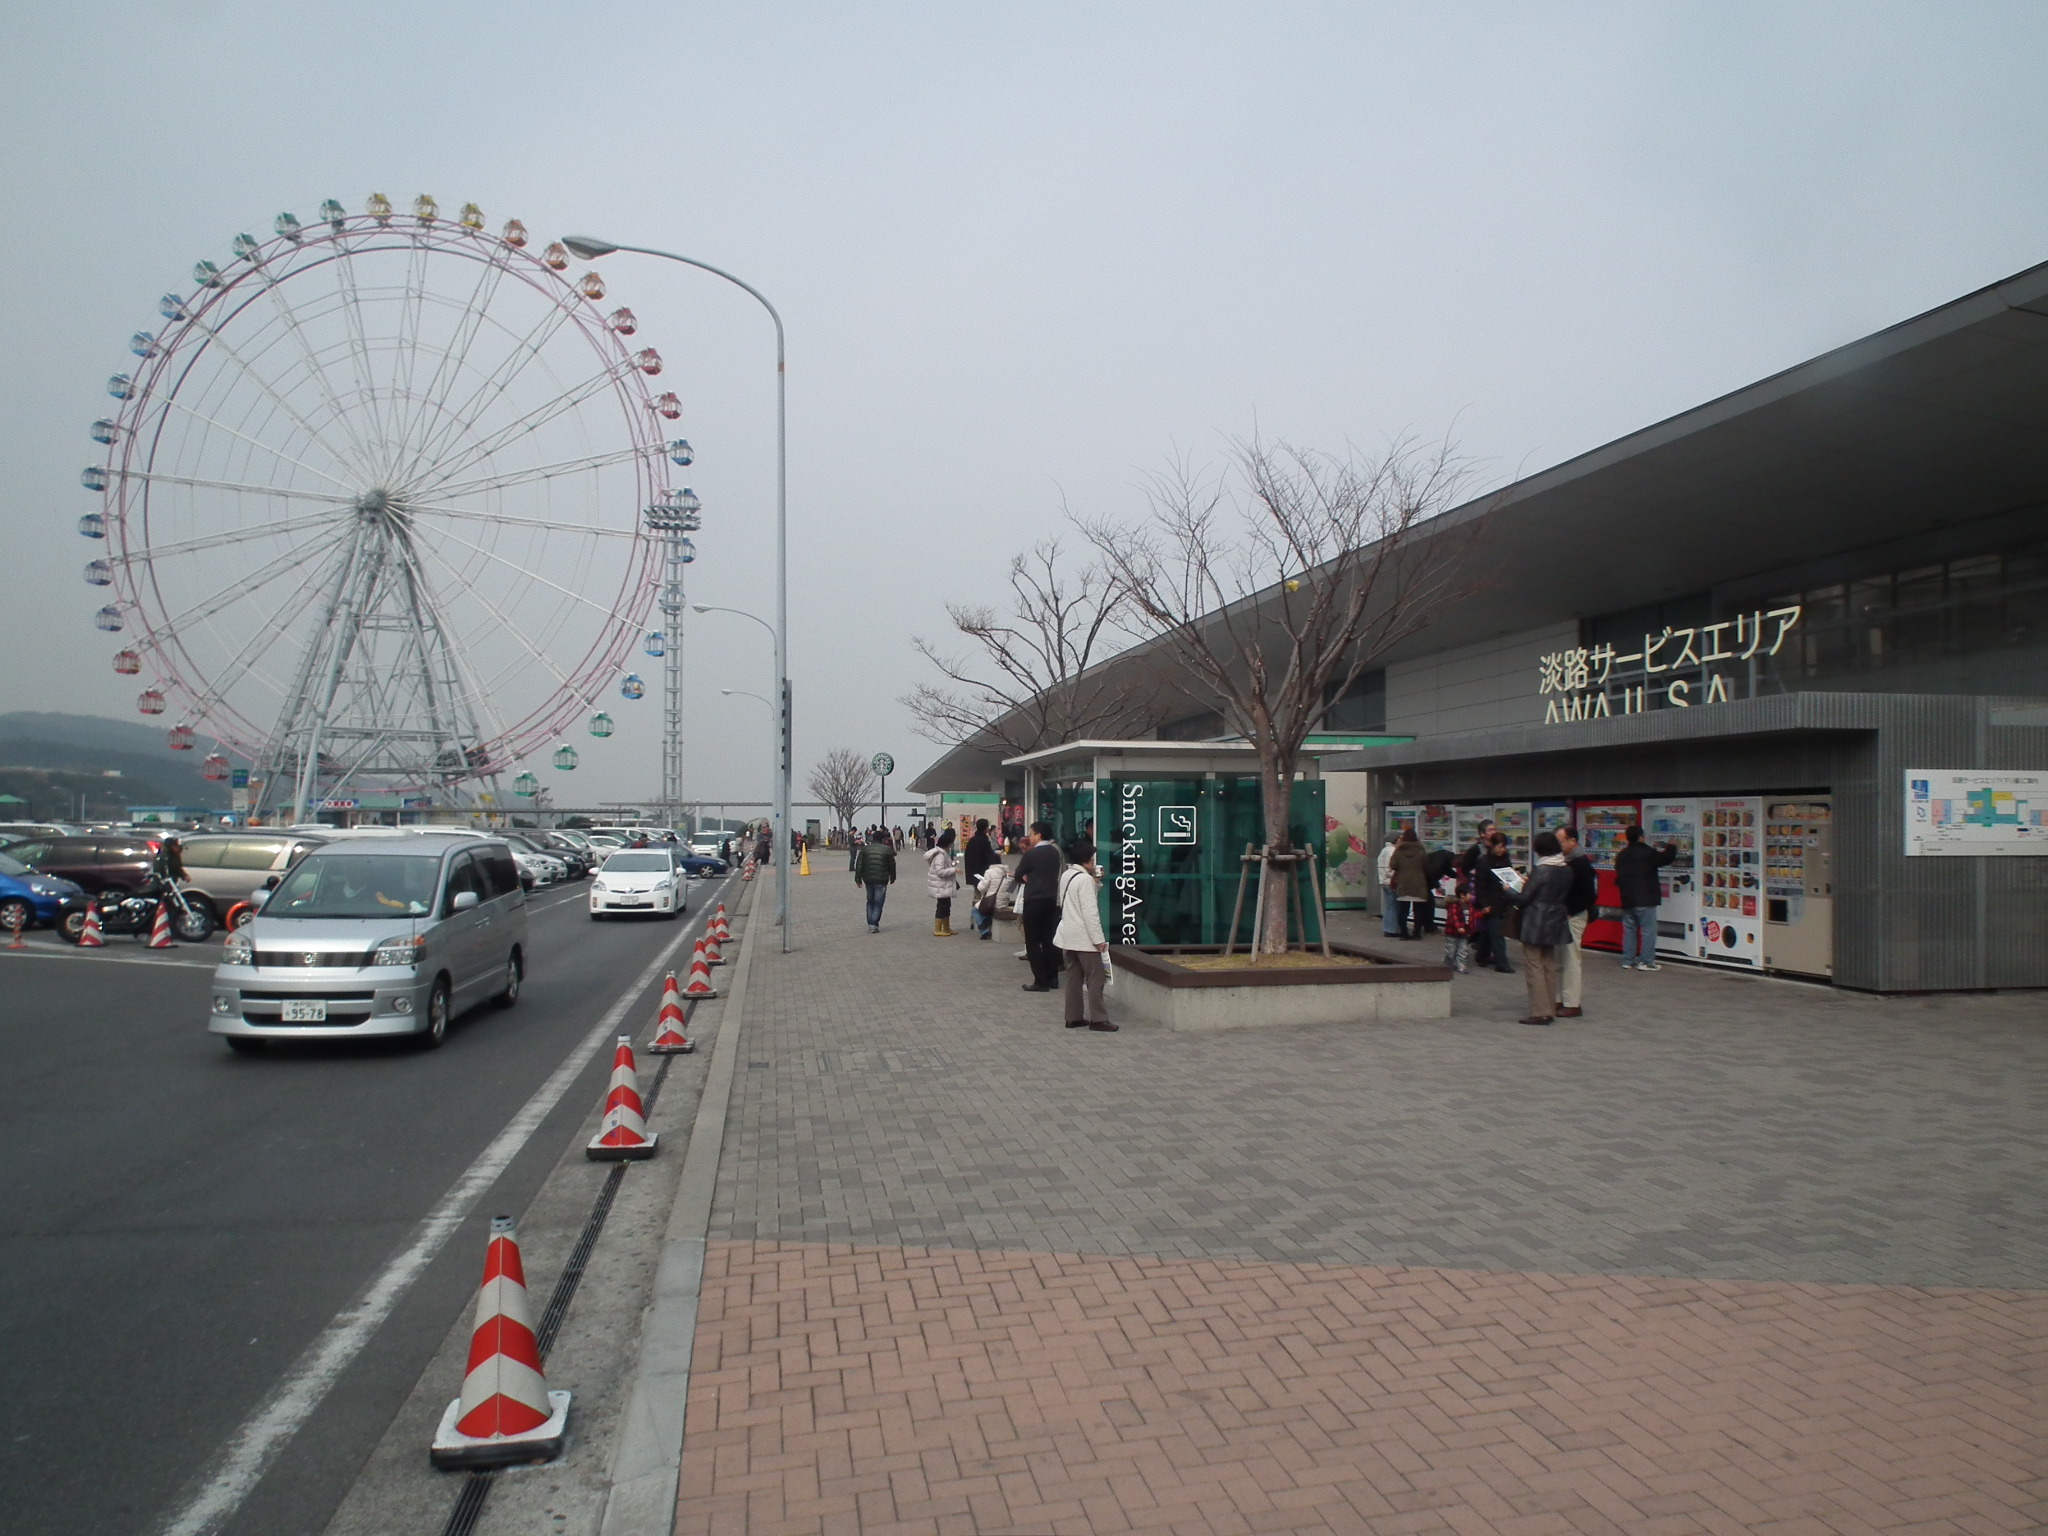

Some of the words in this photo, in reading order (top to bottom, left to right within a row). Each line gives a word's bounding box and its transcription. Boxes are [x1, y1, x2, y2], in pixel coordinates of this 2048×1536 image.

[1539, 605, 1800, 694] 淡路サービスエリア
[291, 1008, 324, 1019] 95-78
